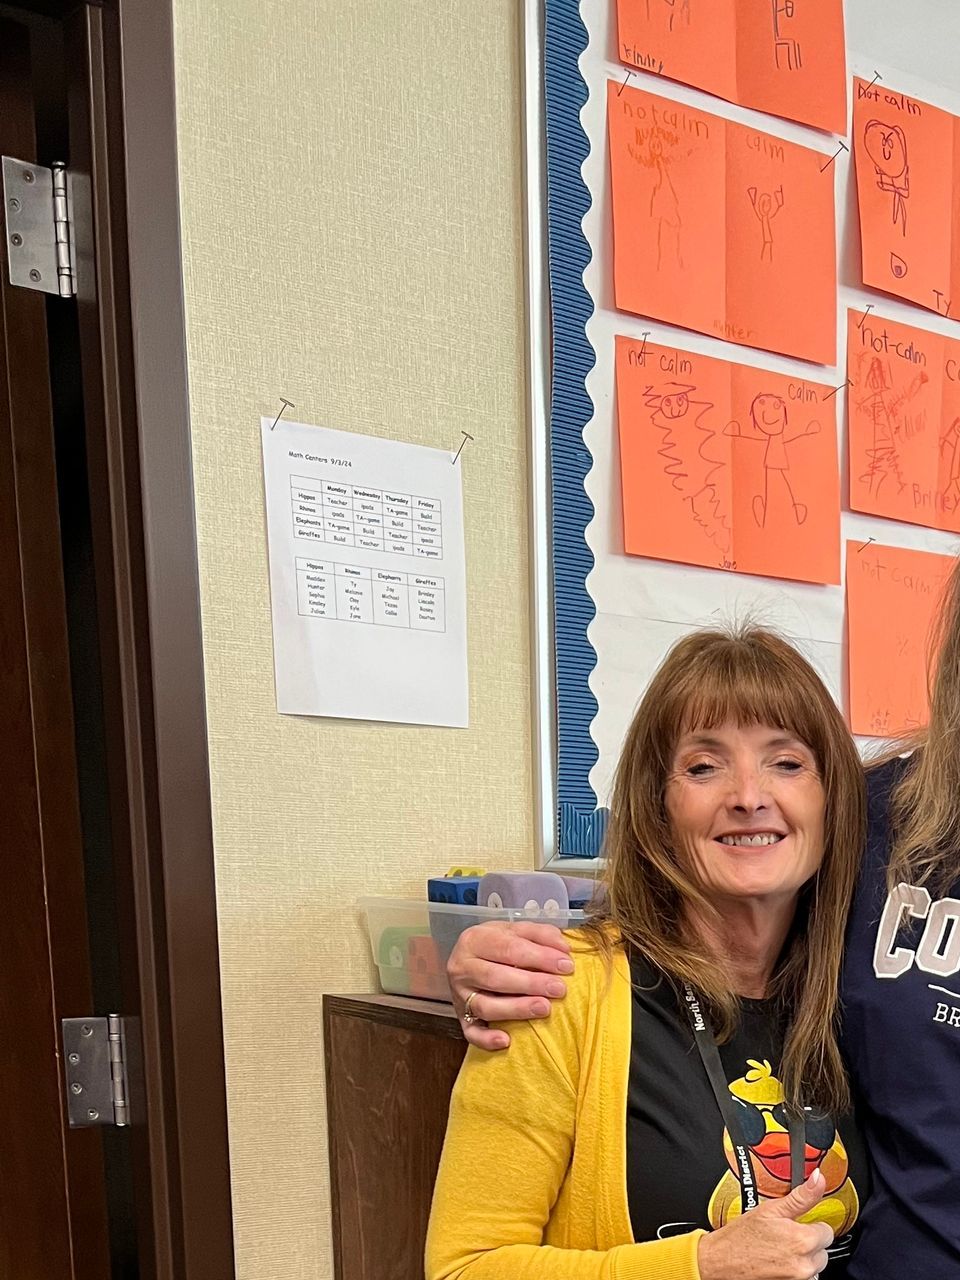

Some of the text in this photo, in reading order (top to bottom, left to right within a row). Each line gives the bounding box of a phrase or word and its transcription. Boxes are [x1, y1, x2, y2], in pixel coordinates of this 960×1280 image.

[932, 289, 952, 317] Ty
[288, 450, 304, 459] Math
[304, 453, 328, 464] Centers
[327, 485, 435, 509] Monday Wednesday Thursday Friday
[327, 497, 348, 506] Teacher
[388, 531, 408, 540] Teacher
[417, 524, 437, 533] Teacher
[298, 529, 321, 539] Giraffes
[359, 539, 380, 548] Teacher
[689, 1001, 706, 1031] North
[736, 1145, 757, 1211] hool District
